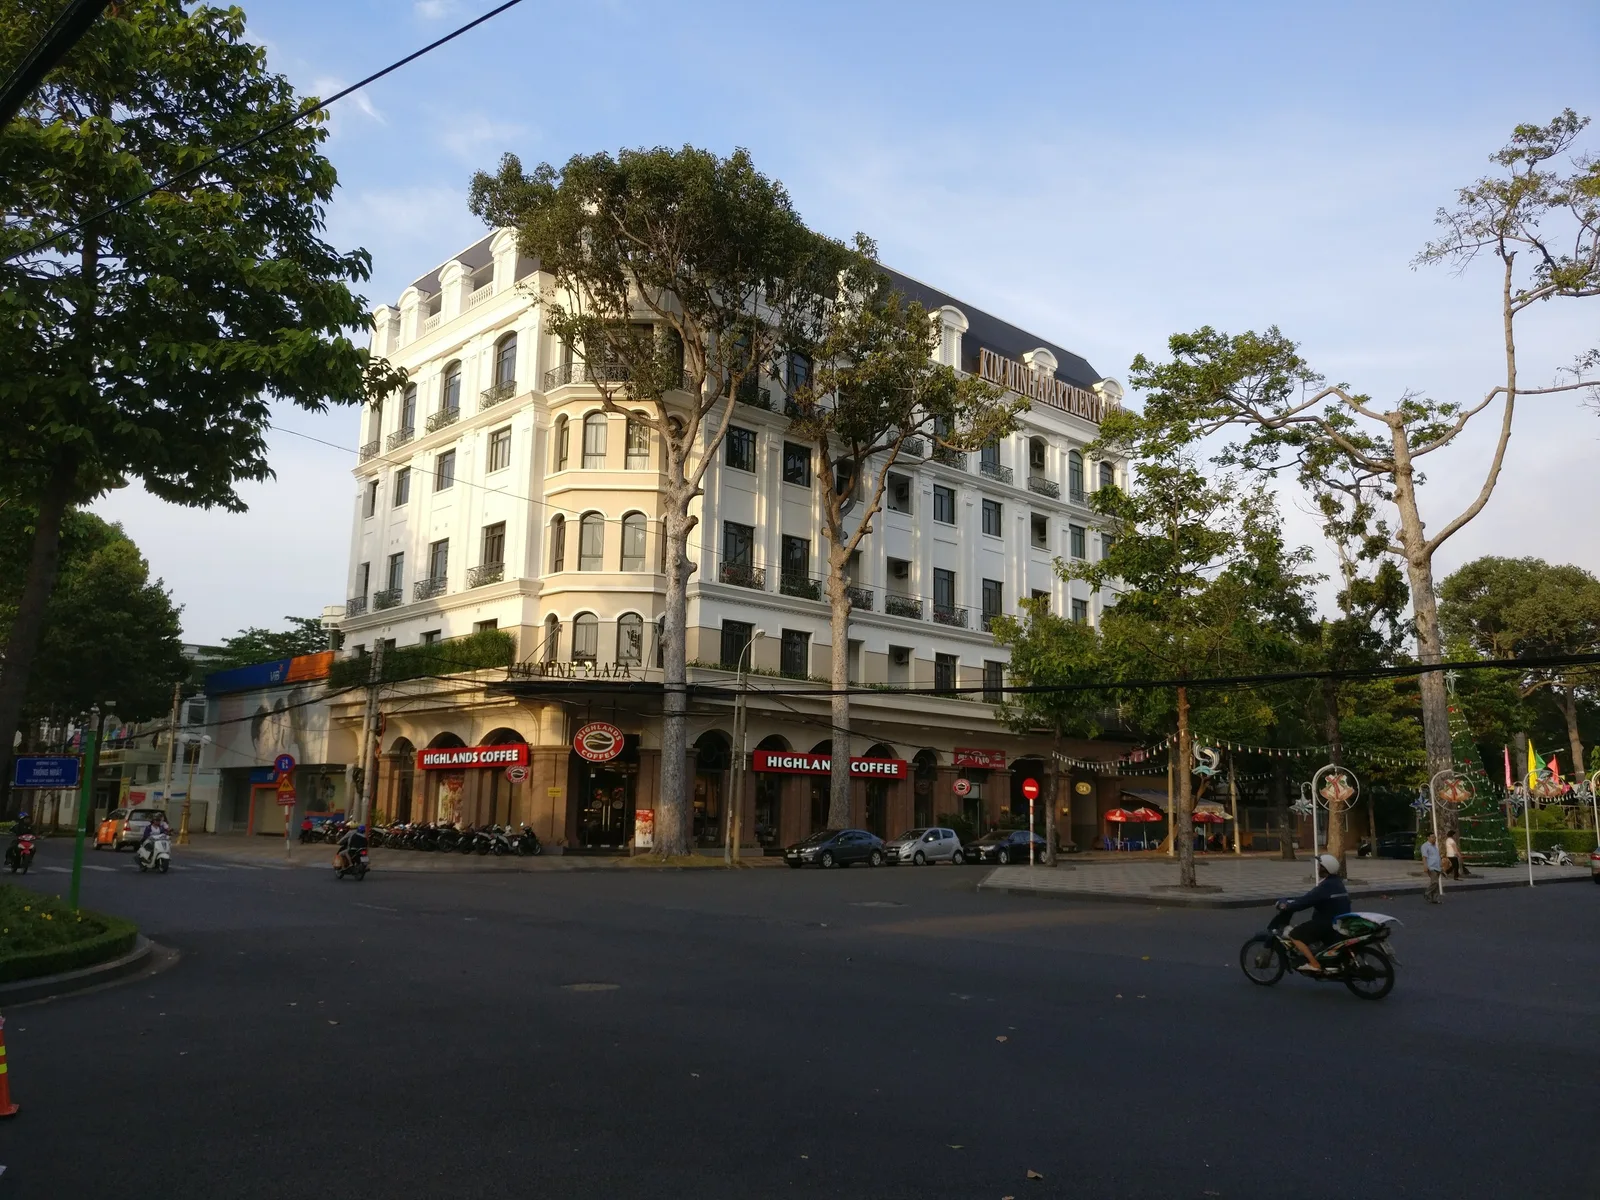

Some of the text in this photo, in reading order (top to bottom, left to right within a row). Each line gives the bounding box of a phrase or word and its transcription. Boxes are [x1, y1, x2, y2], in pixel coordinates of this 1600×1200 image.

[979, 347, 1005, 384] KIM
[1005, 358, 1035, 397] MINH
[1037, 374, 1099, 422] APARTMENT
[507, 661, 631, 679] KIM MINH PLAZA
[577, 724, 622, 741] HIGHLANDS
[423, 749, 519, 765] HIGHLANDS COFFEE
[581, 749, 616, 760] COFFEE
[767, 755, 898, 774] HIGHLAN COFFEE
